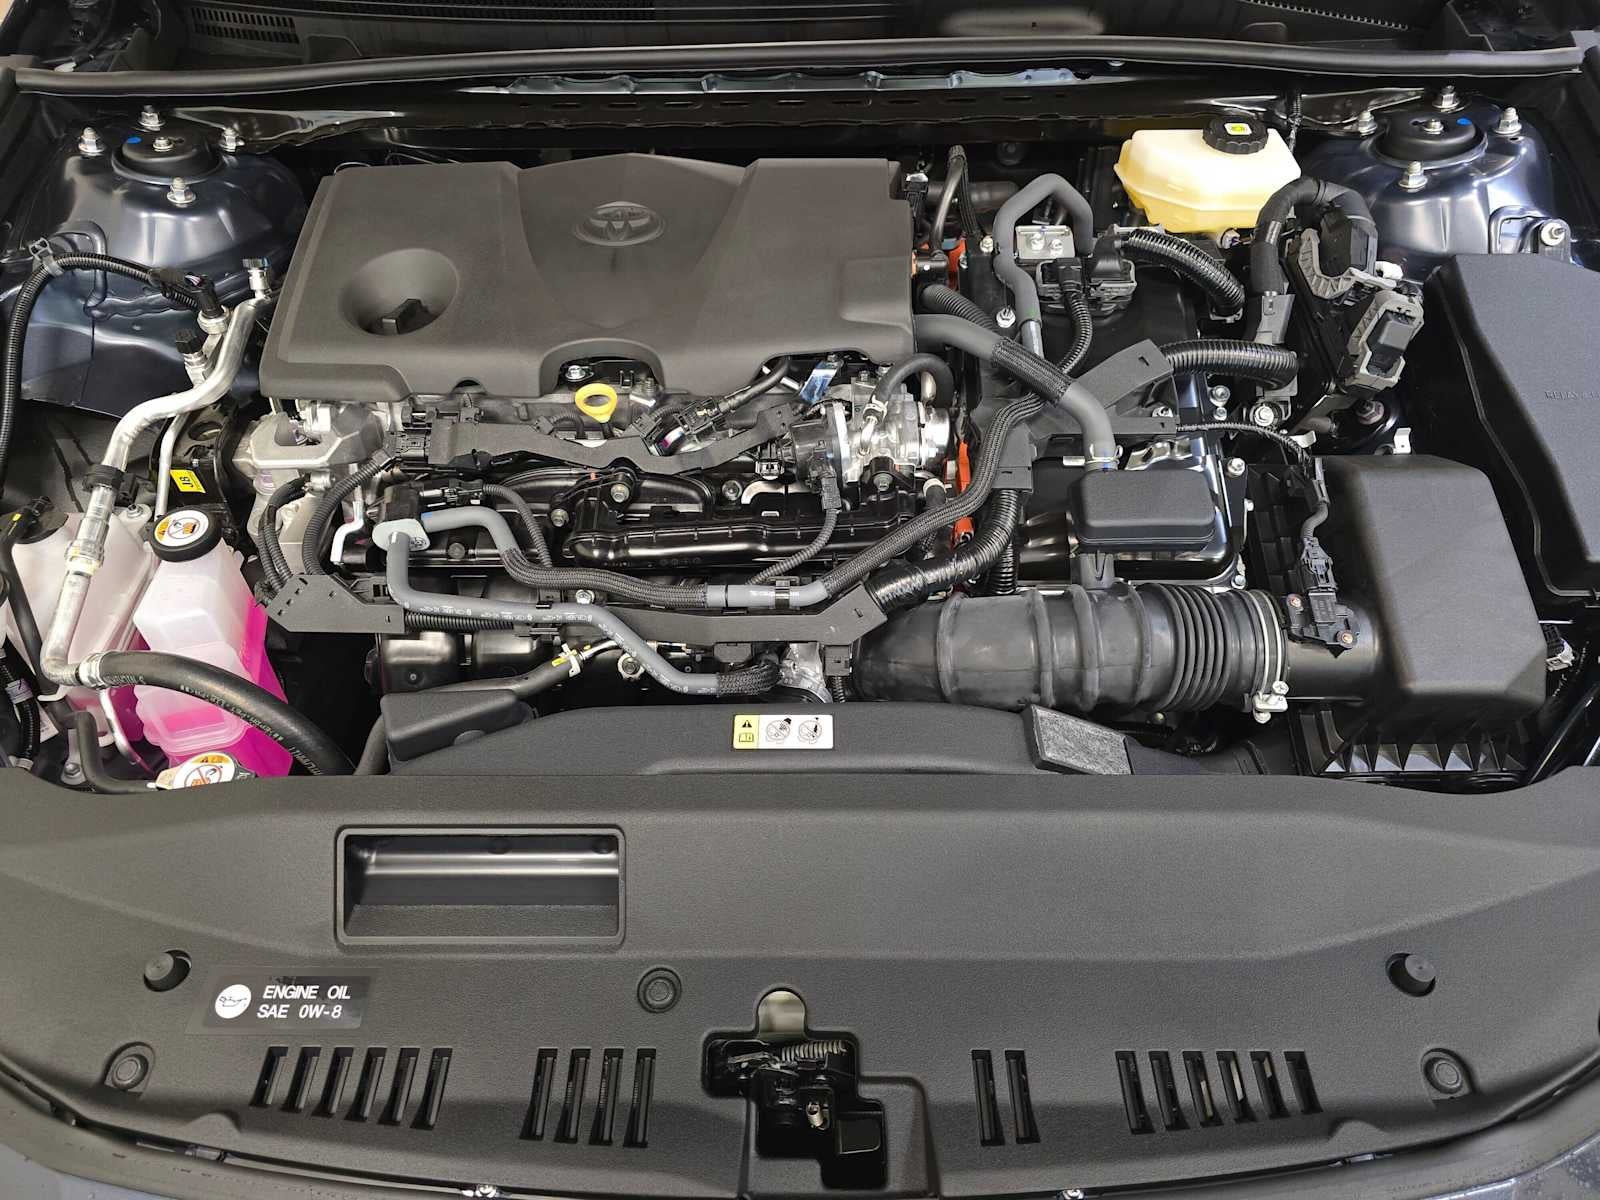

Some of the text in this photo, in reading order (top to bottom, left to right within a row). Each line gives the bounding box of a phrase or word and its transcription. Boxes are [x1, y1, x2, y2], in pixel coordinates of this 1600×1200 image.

[263, 985, 351, 999] ENGINE OIL
[257, 1004, 343, 1019] SAE 0W-8
